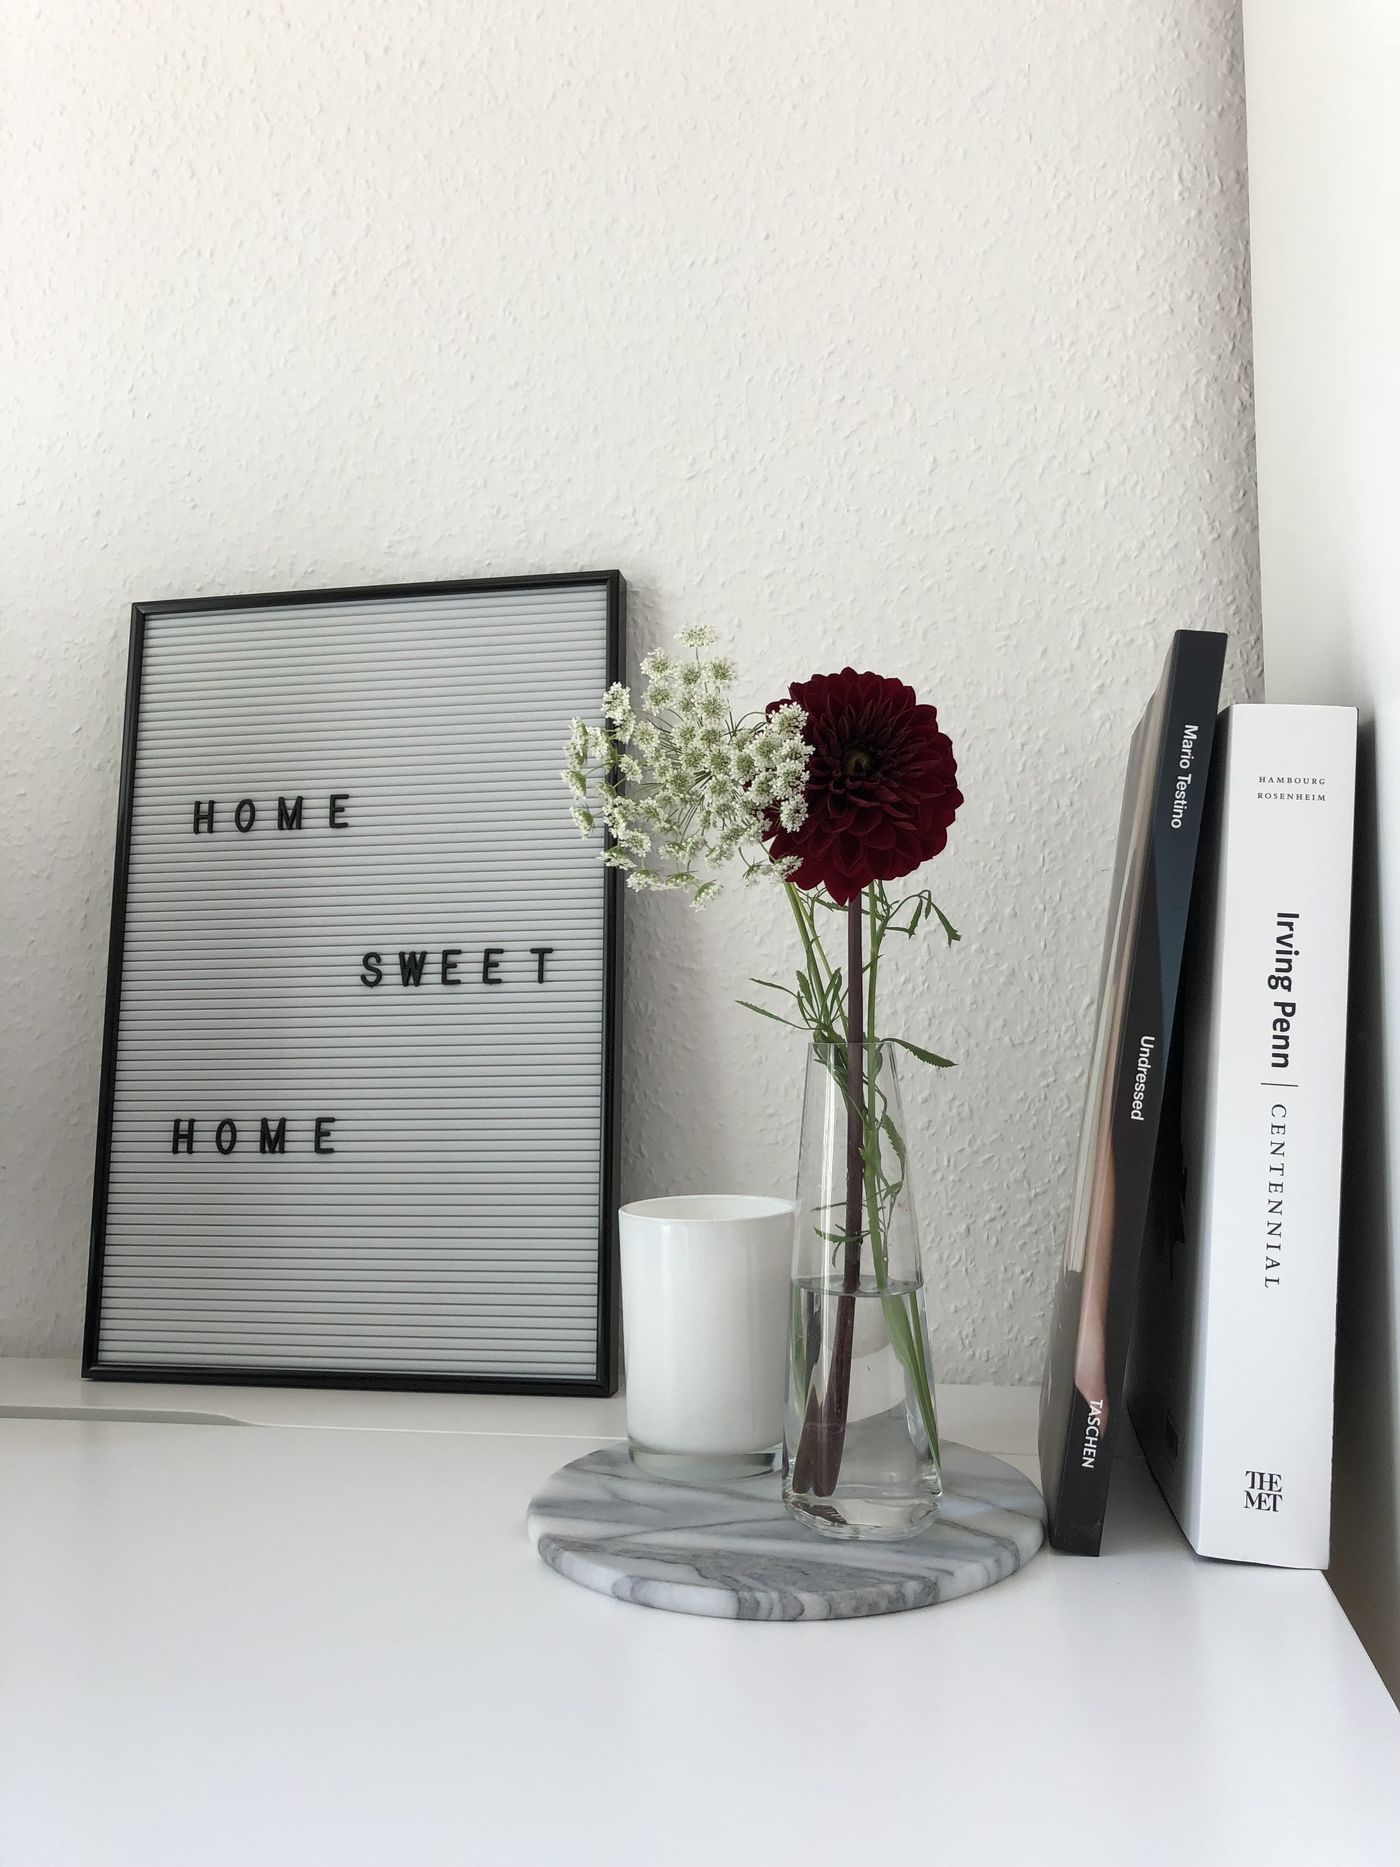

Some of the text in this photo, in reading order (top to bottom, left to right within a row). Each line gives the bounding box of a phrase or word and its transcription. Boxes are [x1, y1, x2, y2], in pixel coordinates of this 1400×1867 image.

[1171, 724, 1199, 829] Mario Testino
[1258, 775, 1326, 785] HAMBOURG
[193, 794, 350, 834] HOME
[1257, 792, 1326, 802] ROSENHEIM
[360, 948, 554, 987] SWEET
[1130, 1035, 1155, 1121] Undressed
[1264, 912, 1300, 1288] Irving Penn CENTENNIAL
[171, 1117, 337, 1155] HOME
[1081, 1399, 1104, 1469] TASCHEN
[1245, 1471, 1282, 1492] THE
[1244, 1492, 1283, 1512] MET
